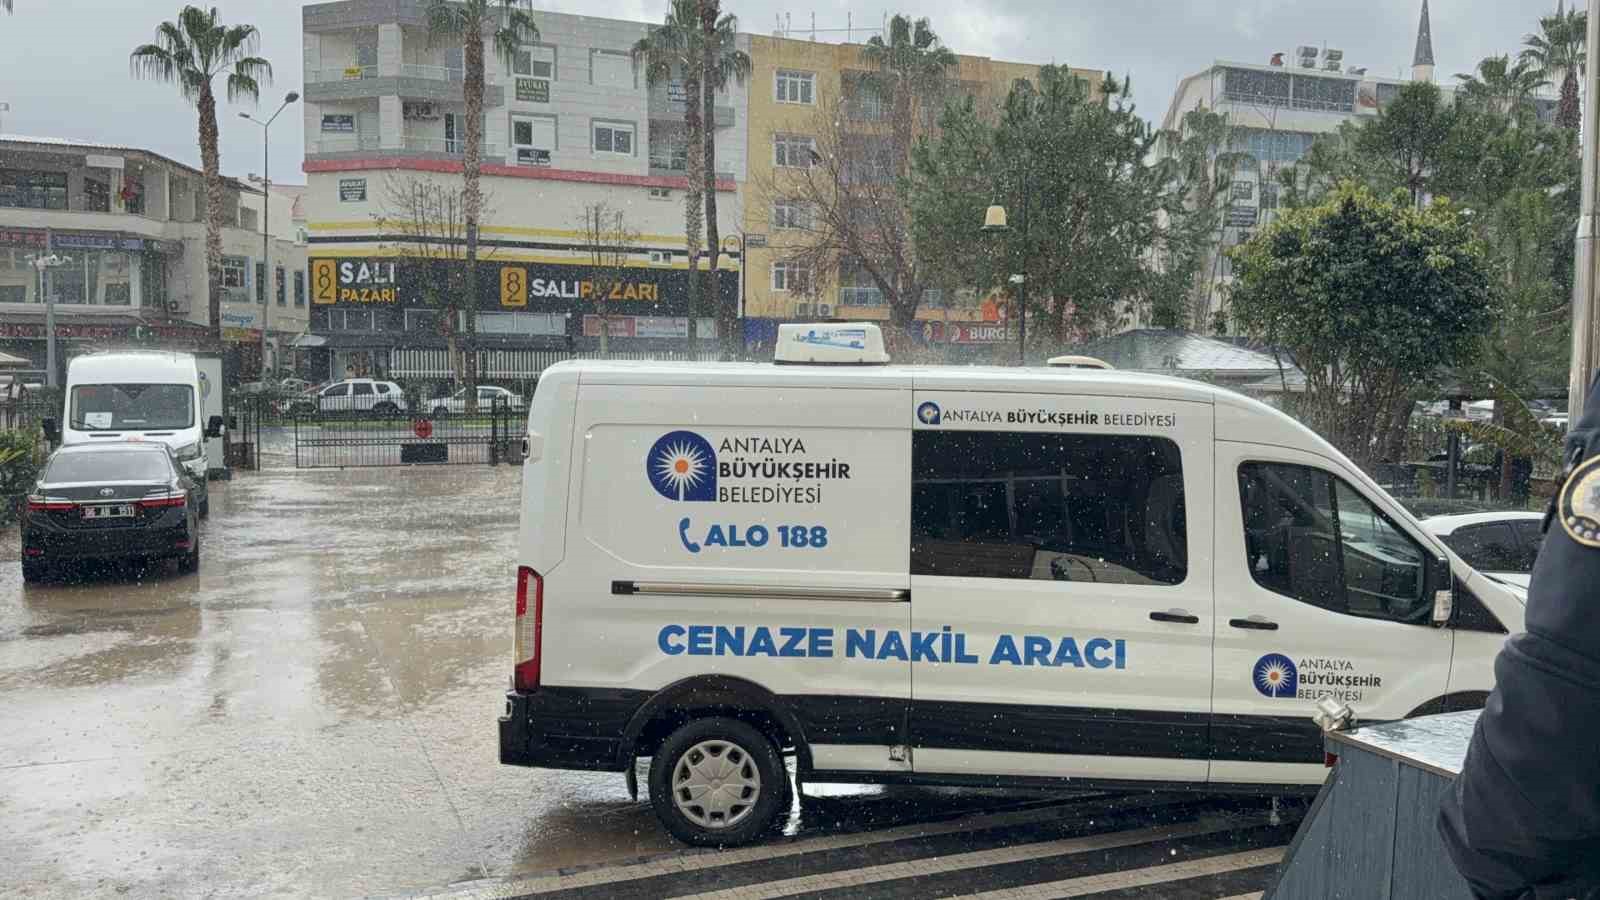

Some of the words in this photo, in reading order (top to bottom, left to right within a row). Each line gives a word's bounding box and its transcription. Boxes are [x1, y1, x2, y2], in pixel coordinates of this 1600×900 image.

[340, 261, 395, 284] SALI
[341, 288, 396, 303] PAZARI
[942, 410, 1002, 424] ANTALYA
[1006, 408, 1099, 428] BÜYÜKŞEHİR
[1103, 410, 1176, 427] BELEDİYESİ
[718, 437, 807, 455] ANTALYA
[718, 458, 851, 482] BÜYÜKŞEHİR
[719, 483, 822, 504] BELEDİYESİ
[703, 524, 769, 548] ALO
[777, 525, 828, 548] 188
[657, 625, 835, 657] CENAZE
[845, 625, 979, 664] NAKİL
[988, 634, 1126, 669] ARACI
[1298, 659, 1354, 671] ANTALYA
[1298, 671, 1382, 689] BÜYÜKŞEHİR
